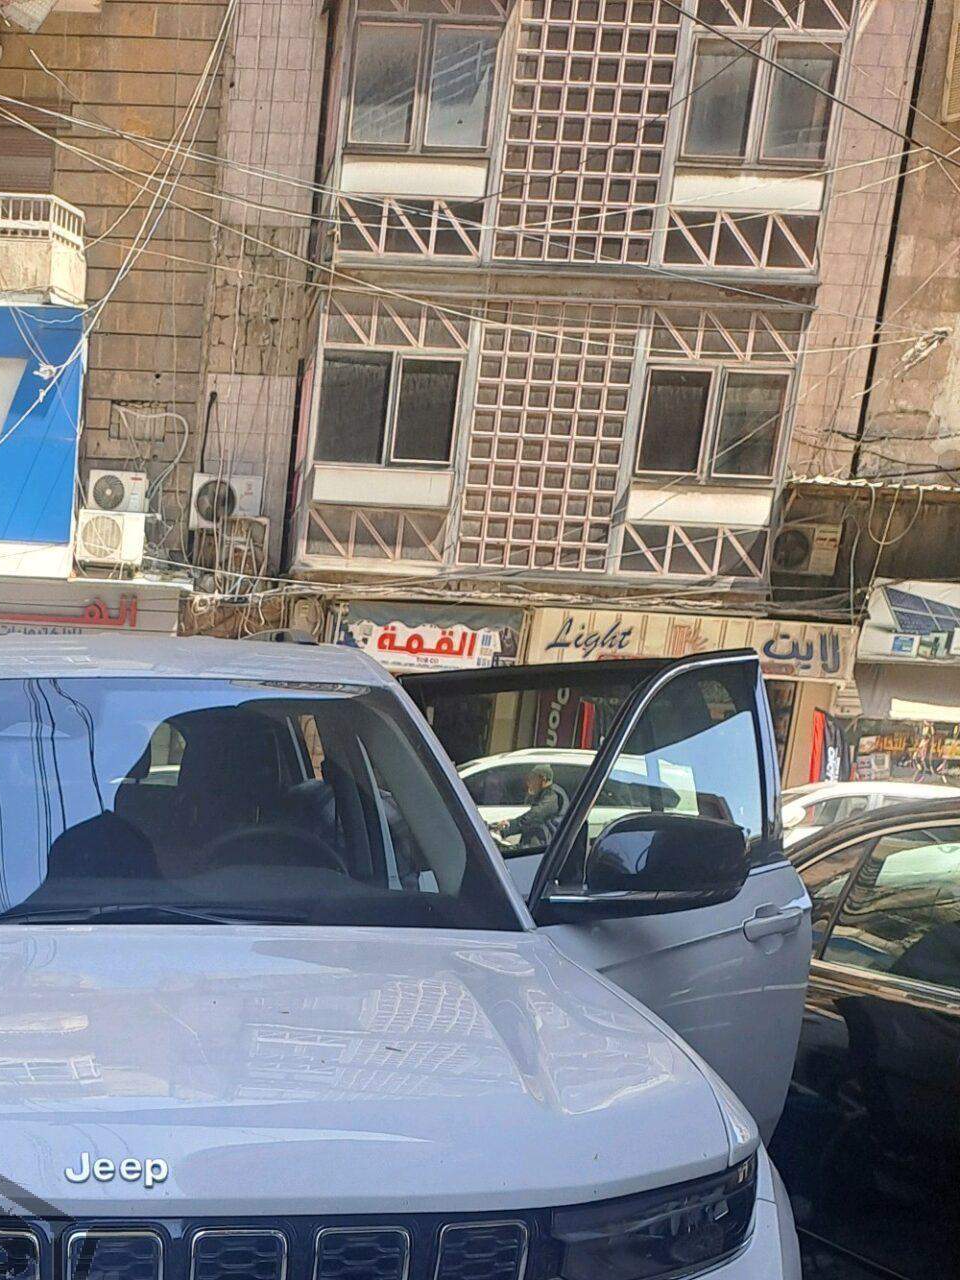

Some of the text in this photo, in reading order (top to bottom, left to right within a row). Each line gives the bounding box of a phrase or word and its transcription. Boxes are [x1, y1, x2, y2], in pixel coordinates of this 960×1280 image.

[377, 625, 477, 658] القمة
[545, 615, 634, 657] Light
[763, 629, 841, 673] لايت
[65, 1151, 169, 1188] Jeep
